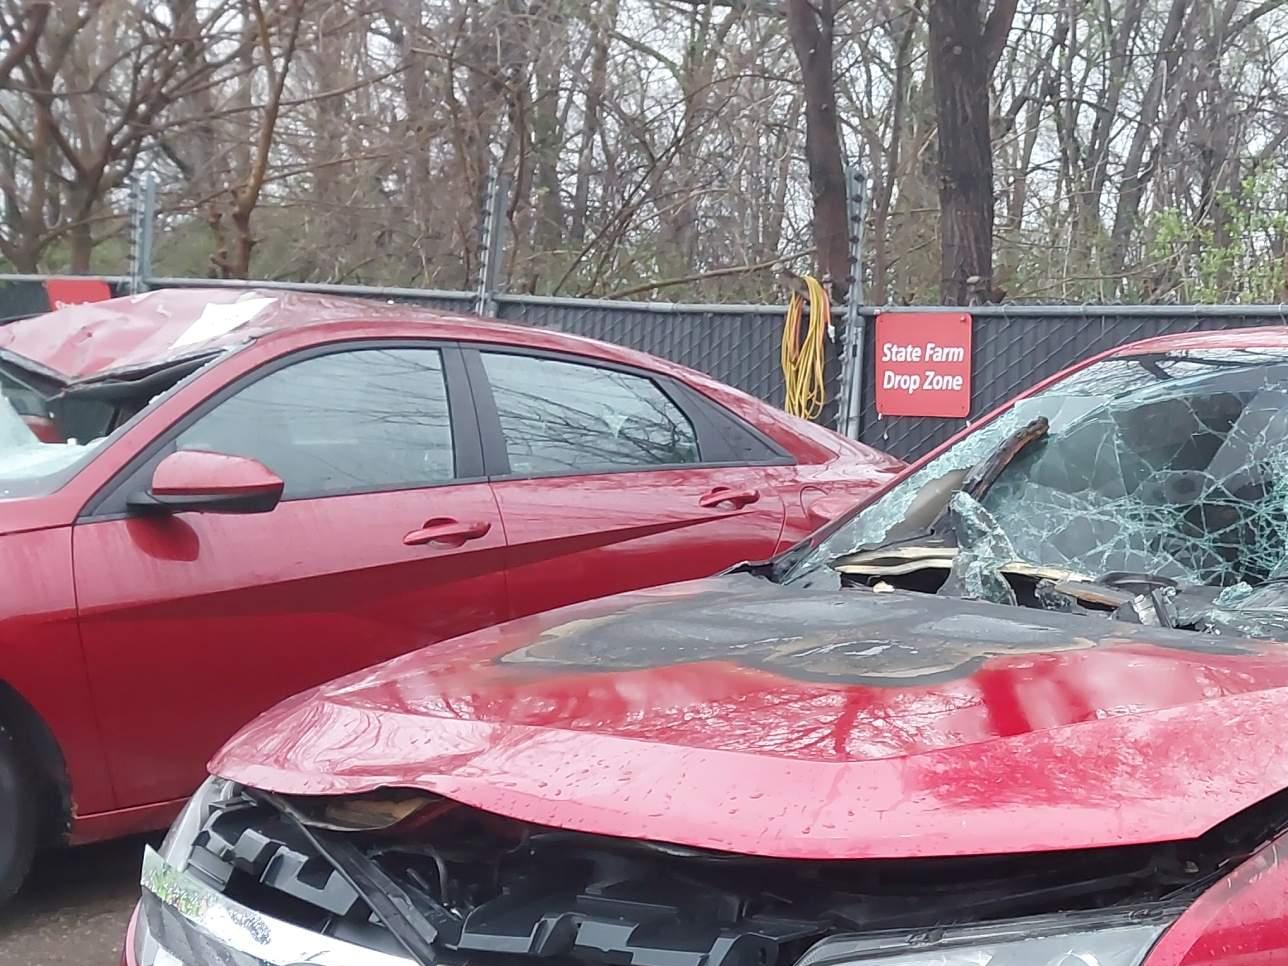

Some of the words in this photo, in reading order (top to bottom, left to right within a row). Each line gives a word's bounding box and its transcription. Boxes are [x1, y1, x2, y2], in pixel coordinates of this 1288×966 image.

[881, 343, 921, 362] State
[925, 343, 964, 362] Farm
[883, 371, 920, 394] Drop
[923, 371, 963, 390] Zone
